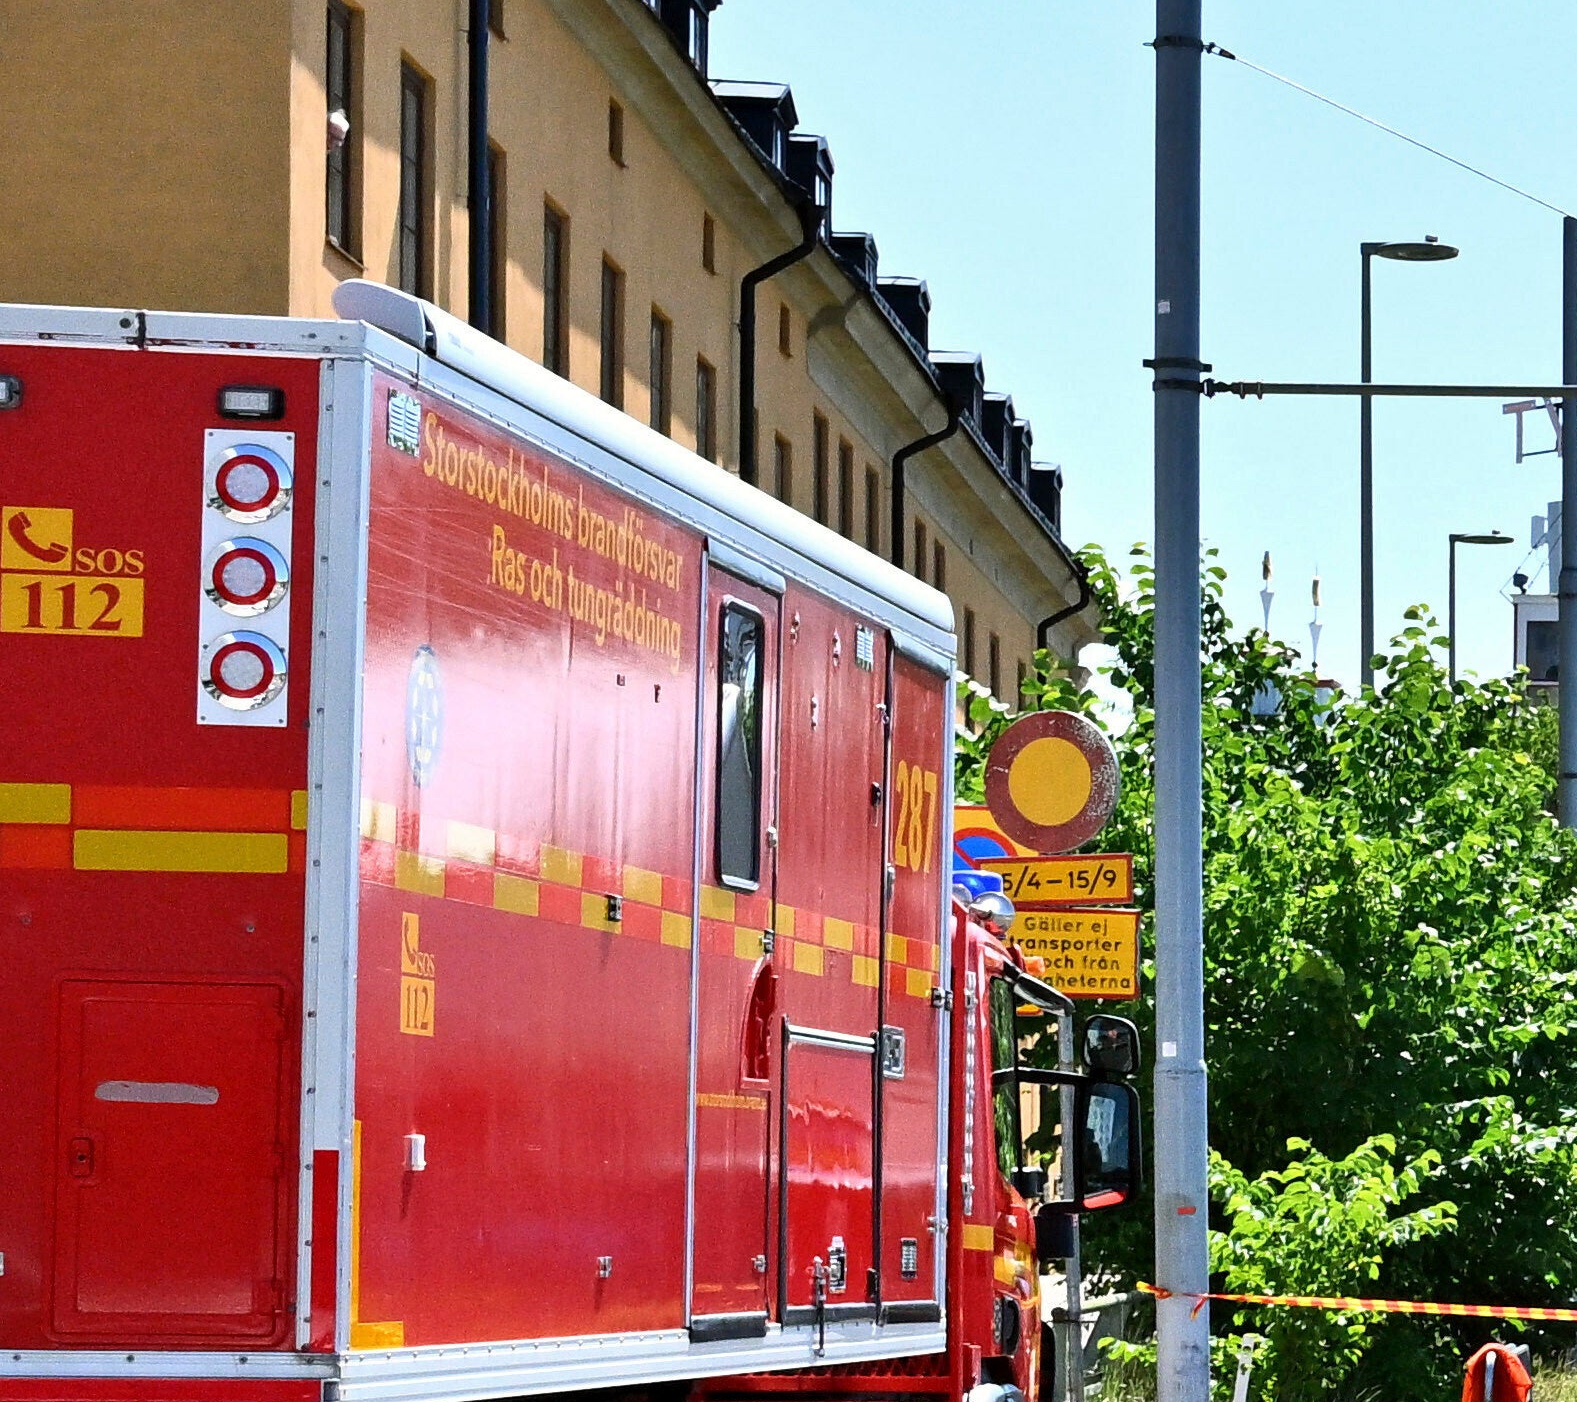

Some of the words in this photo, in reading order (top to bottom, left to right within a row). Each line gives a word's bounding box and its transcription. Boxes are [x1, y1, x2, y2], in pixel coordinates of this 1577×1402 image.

[423, 412, 573, 541] Storstockholms
[578, 484, 683, 592] brandförsvar
[75, 548, 145, 575] SOS
[20, 581, 123, 631] 112
[491, 523, 525, 595] Ras
[530, 547, 562, 611] och
[567, 565, 681, 675] tungräddning
[894, 759, 938, 874] 287
[1009, 935, 1121, 952] transporter
[1024, 916, 1083, 932] Gäller
[1091, 918, 1108, 936] ej
[1083, 955, 1120, 971] från
[406, 984, 429, 1030] 112
